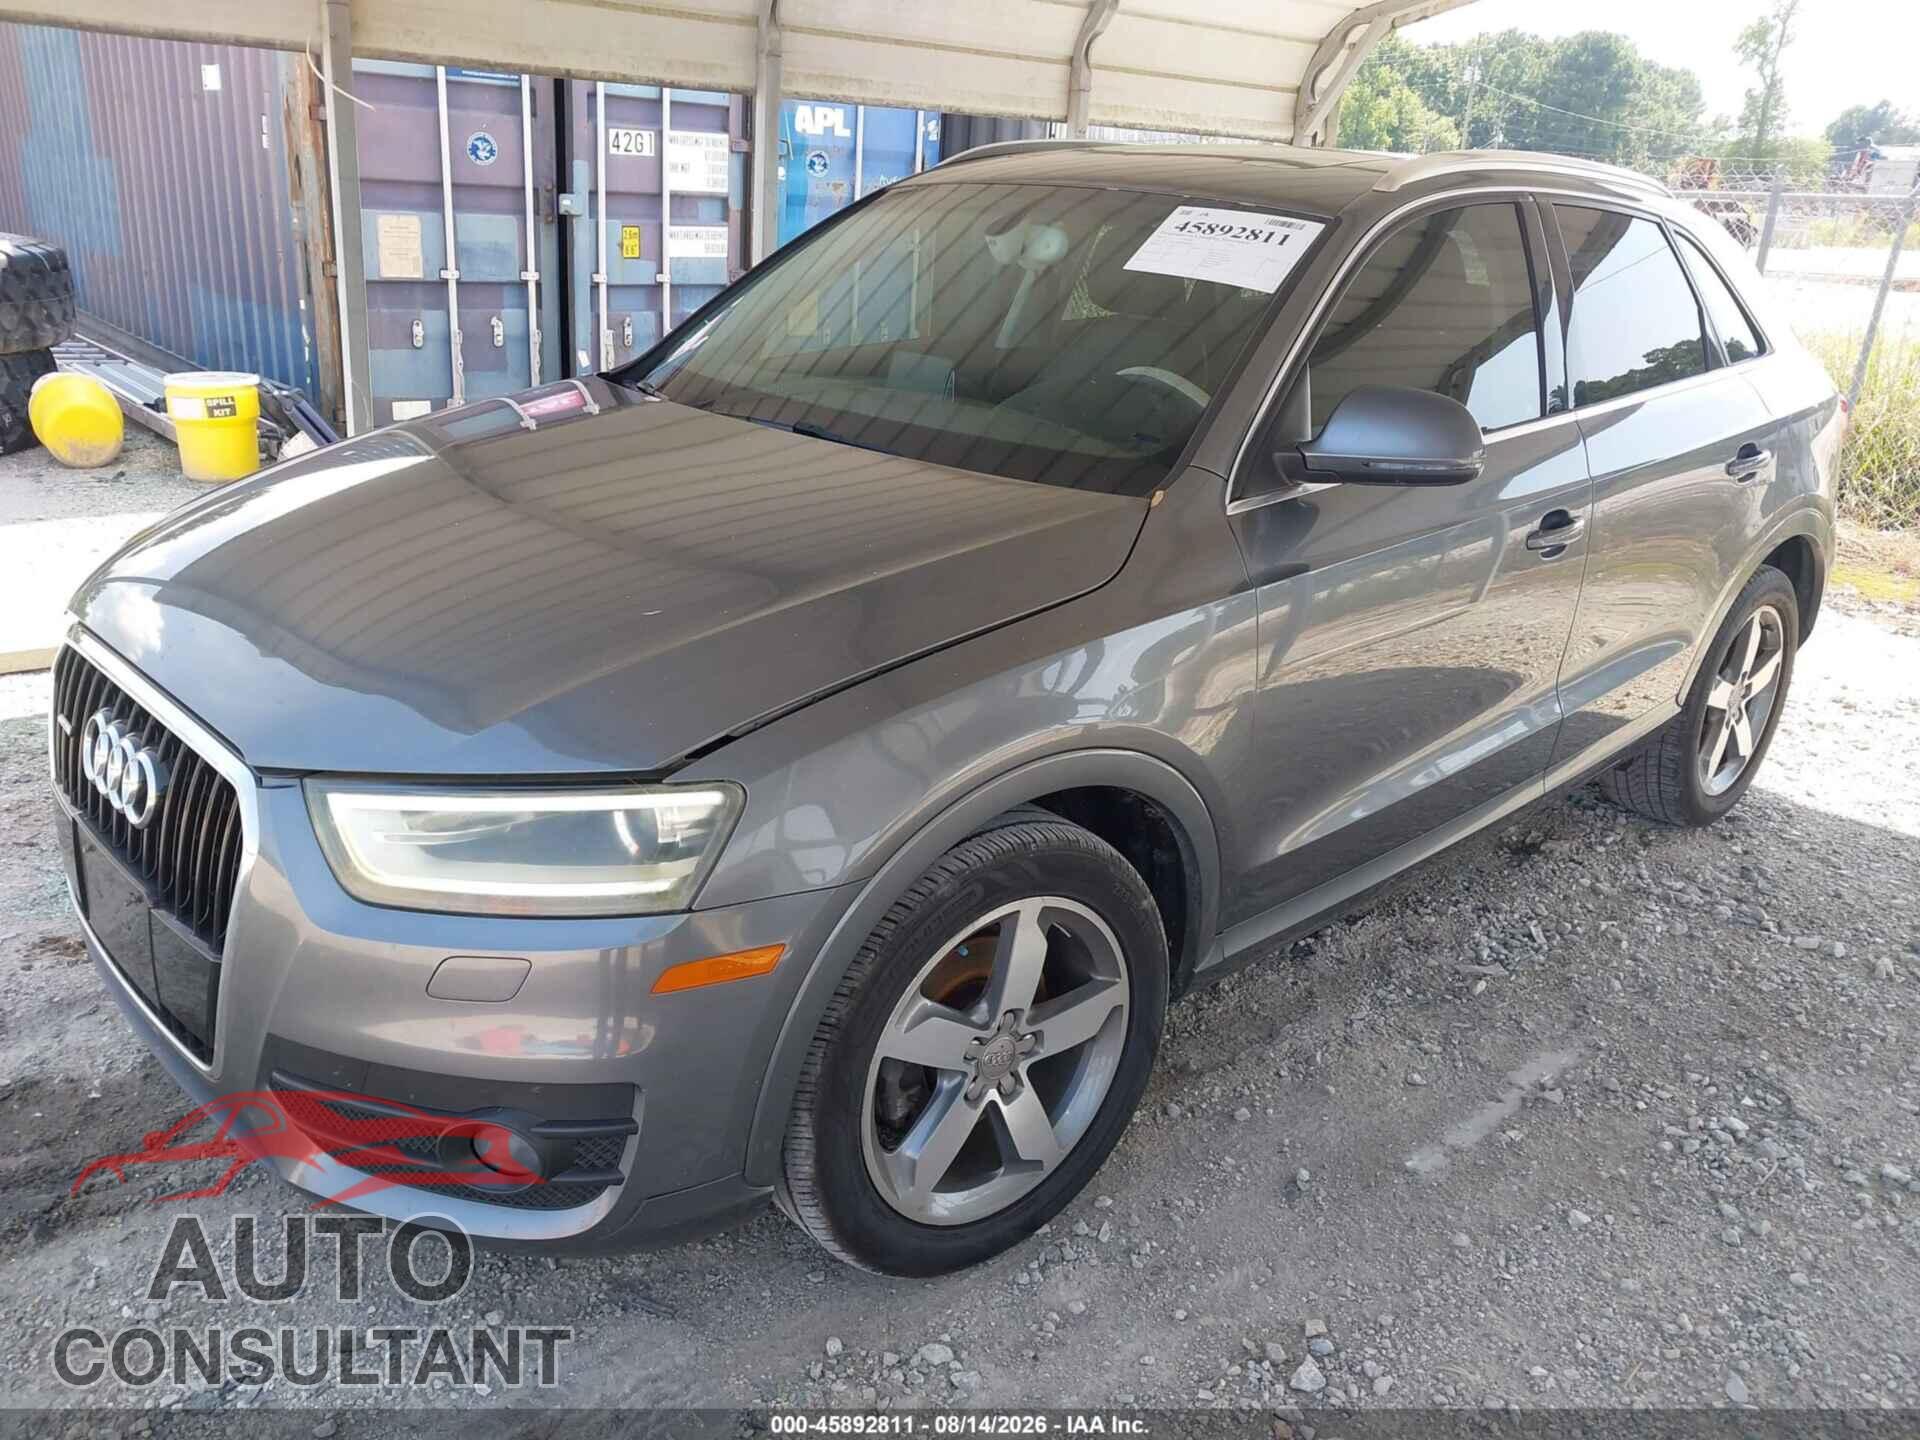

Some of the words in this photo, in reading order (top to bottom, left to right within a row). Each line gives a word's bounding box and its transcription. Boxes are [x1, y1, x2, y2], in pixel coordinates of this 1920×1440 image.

[795, 105, 851, 137] APL
[611, 131, 654, 154] 42G1
[1174, 220, 1291, 246] 45892811
[206, 397, 234, 407] SPILL
[213, 408, 231, 417] KIT
